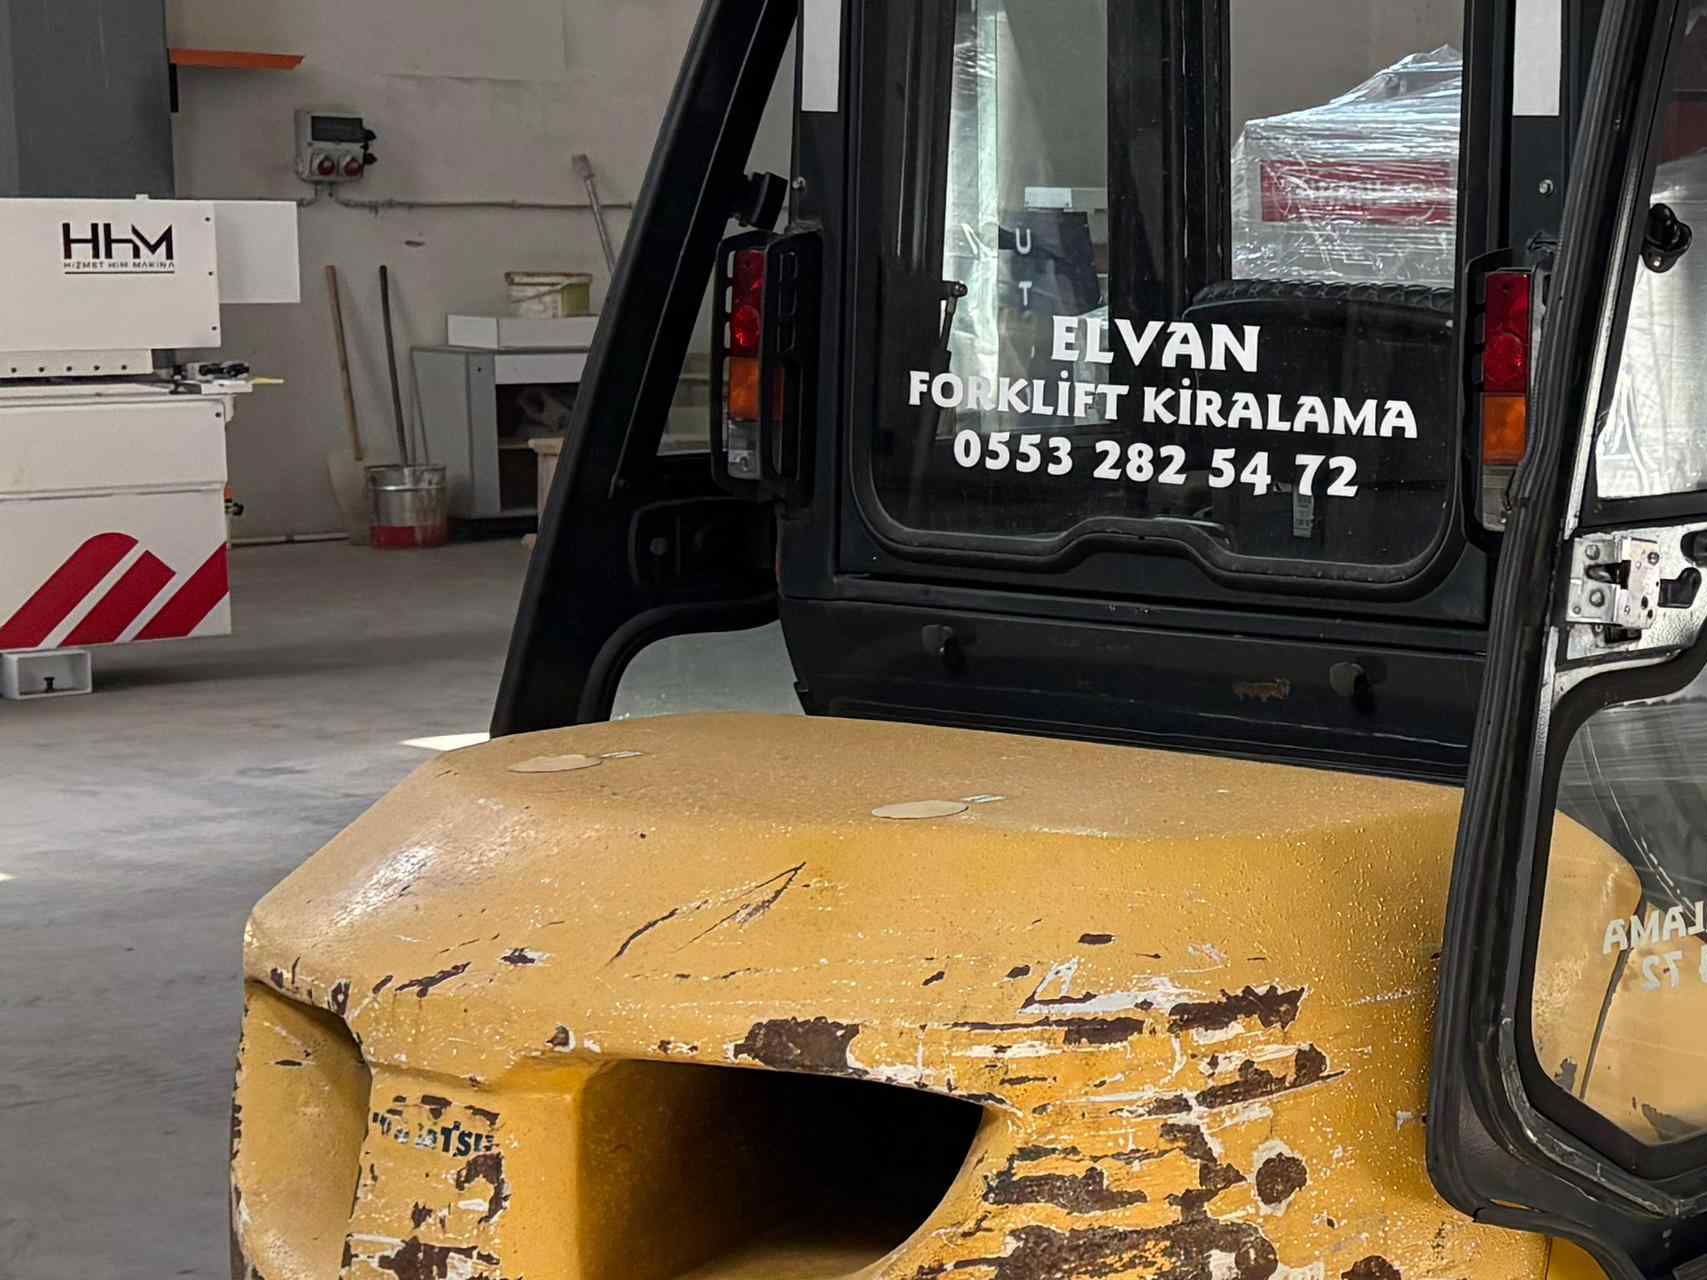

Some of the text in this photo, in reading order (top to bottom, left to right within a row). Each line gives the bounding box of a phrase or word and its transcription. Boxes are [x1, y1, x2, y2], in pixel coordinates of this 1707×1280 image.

[1052, 315, 1261, 372] ELVAN
[909, 370, 1418, 439] FORKLİFT KİRALAMA
[953, 429, 1358, 497] 0553 282 54 72
